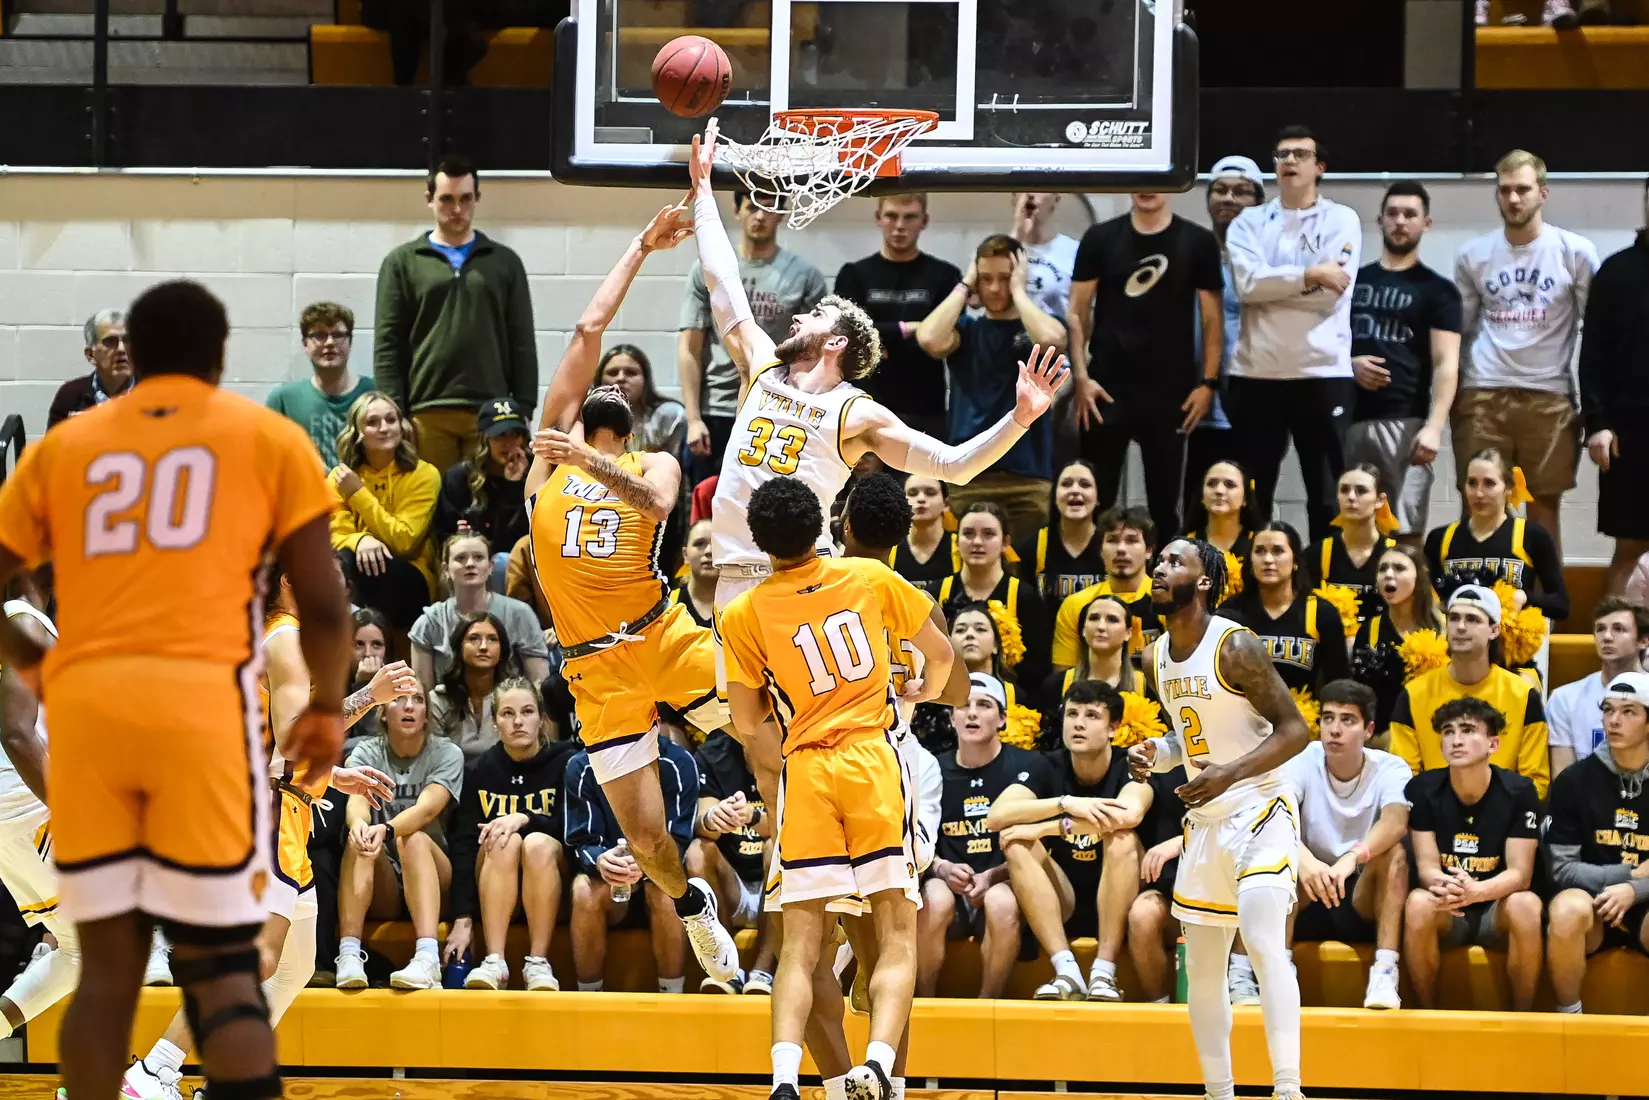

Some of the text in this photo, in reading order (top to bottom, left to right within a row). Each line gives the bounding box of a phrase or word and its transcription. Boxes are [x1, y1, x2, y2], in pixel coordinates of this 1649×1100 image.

[1089, 121, 1149, 135] SCHUTT
[1112, 135, 1143, 144] SPORTS
[1485, 268, 1555, 295] COORS
[759, 390, 826, 430] VILLE
[738, 416, 808, 475] 33
[84, 445, 217, 560] 20
[561, 505, 621, 558] 13
[792, 609, 875, 697] 10
[1163, 675, 1211, 703] VILLE
[1180, 706, 1209, 757] 2
